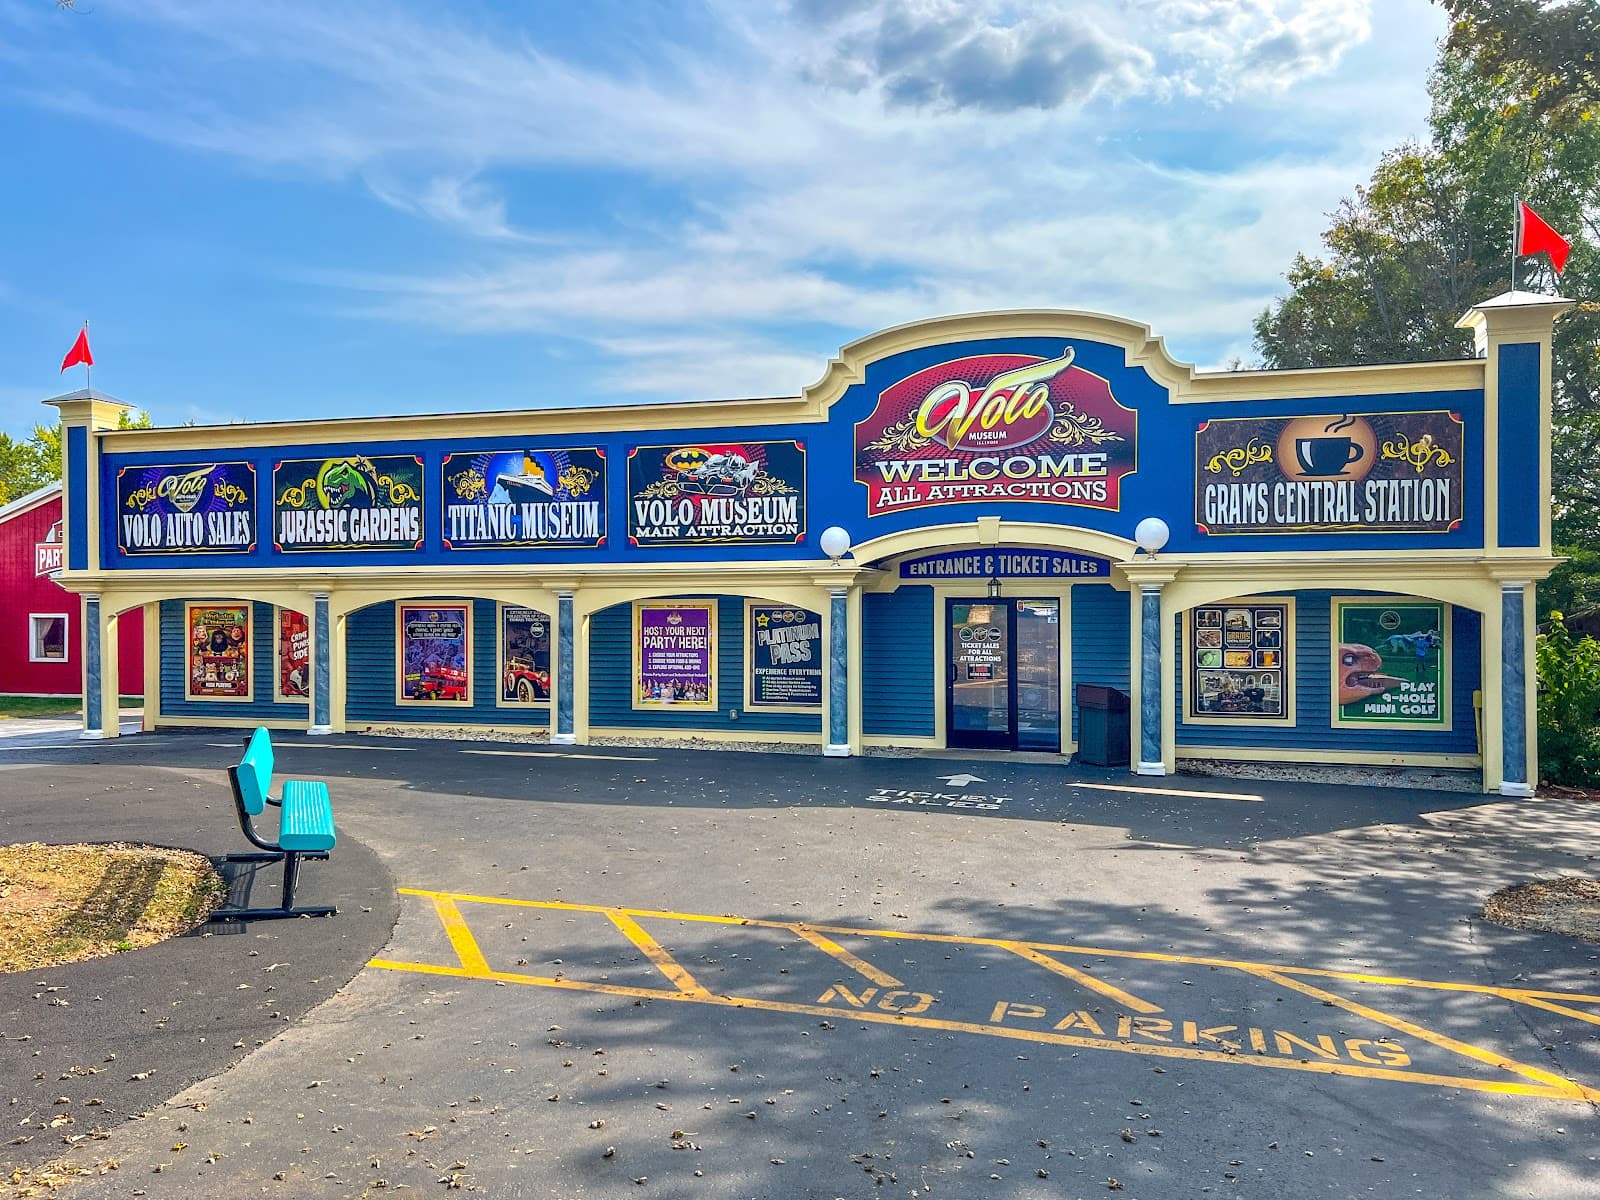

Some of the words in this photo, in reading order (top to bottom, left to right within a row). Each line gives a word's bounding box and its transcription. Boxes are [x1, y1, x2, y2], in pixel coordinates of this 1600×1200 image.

[969, 431, 1007, 441] MUSEUM
[875, 453, 1108, 483] WELCOME
[876, 487, 921, 508] ALL
[926, 481, 1108, 502] ATTRACTIONS
[1204, 482, 1268, 525] GRAMS
[1274, 480, 1359, 524] CENTRAL
[1365, 478, 1450, 522] STATION
[448, 503, 517, 540] TITANIC
[521, 501, 600, 539] MUSEUM
[635, 499, 694, 526] VOLO
[701, 496, 798, 526] MUSEUM
[123, 513, 161, 547] VOLO
[166, 512, 204, 546] AUTO
[208, 510, 251, 545] SALES
[279, 509, 347, 544] JURASSIC
[350, 507, 419, 541] GARDENS
[636, 525, 680, 538] MAIN
[686, 523, 798, 537] ATTRACTION
[910, 556, 980, 575] ENTRANCE
[986, 556, 995, 574] &
[1000, 554, 1049, 575] TICKET
[1053, 559, 1097, 574] SALES
[644, 626, 663, 636] HOST
[665, 626, 685, 636] YOUR
[686, 626, 706, 636] NEXT
[757, 623, 820, 646] PLATINUM
[643, 636, 676, 649] PARTY
[678, 636, 707, 649] HERE!
[770, 640, 812, 665] PASS
[755, 667, 788, 675] EXPERIENCE
[1400, 682, 1436, 692] PLAY
[1364, 703, 1396, 714] MINI
[1400, 704, 1436, 715] GOLF
[1382, 693, 1436, 704] 9-HOLE
[865, 795, 1001, 810] SALES
[874, 788, 1013, 804] TICKET
[816, 984, 935, 1013] NO
[990, 1000, 1412, 1067] PARKING
